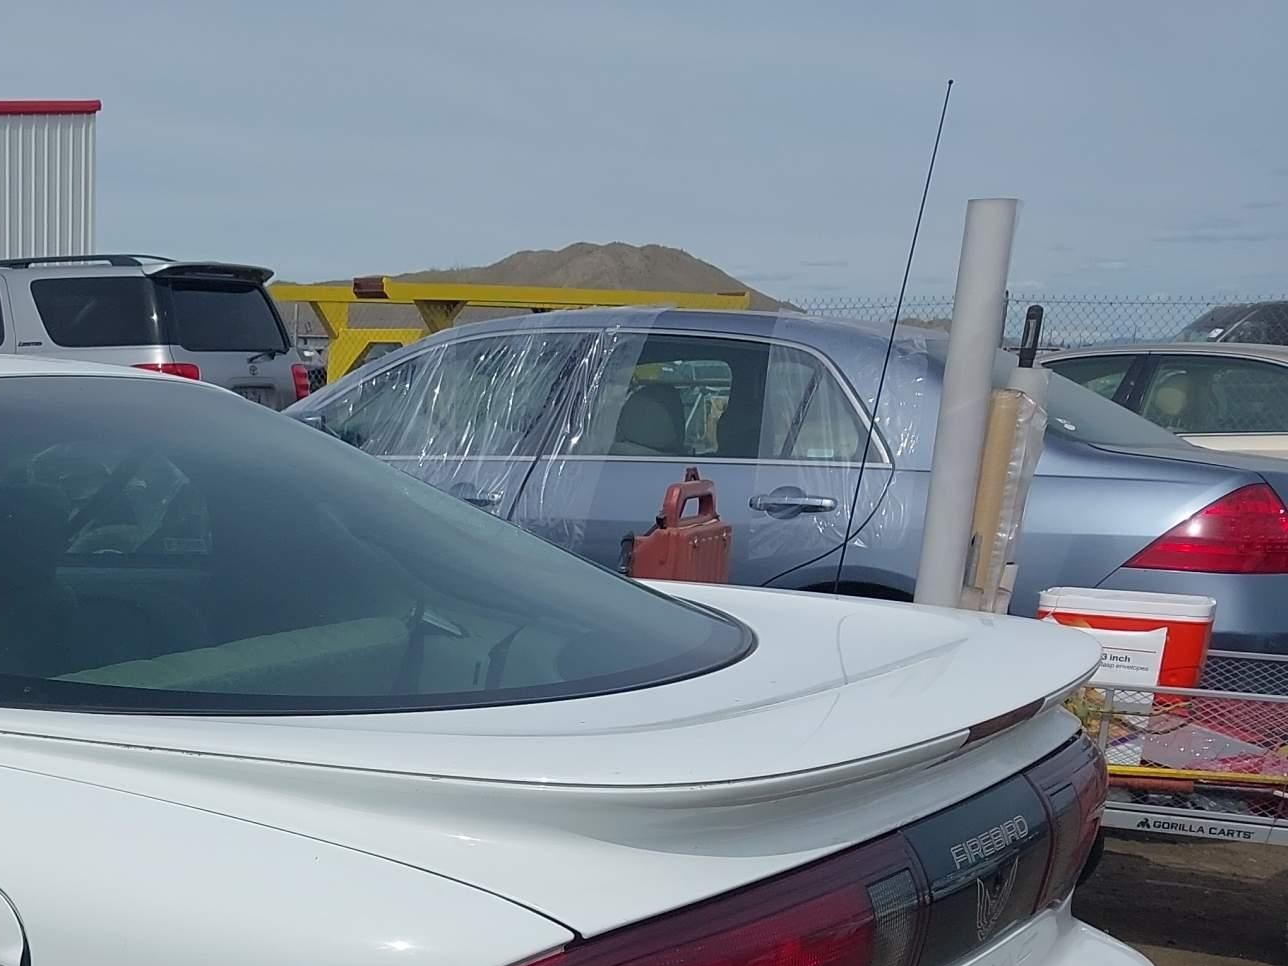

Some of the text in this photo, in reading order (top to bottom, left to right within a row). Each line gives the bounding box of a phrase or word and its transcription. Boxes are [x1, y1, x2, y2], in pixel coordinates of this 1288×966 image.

[1109, 653, 1131, 663] inch
[1153, 820, 1252, 840] GORILLA CARTS
[950, 815, 1029, 869] FIREBIRD
